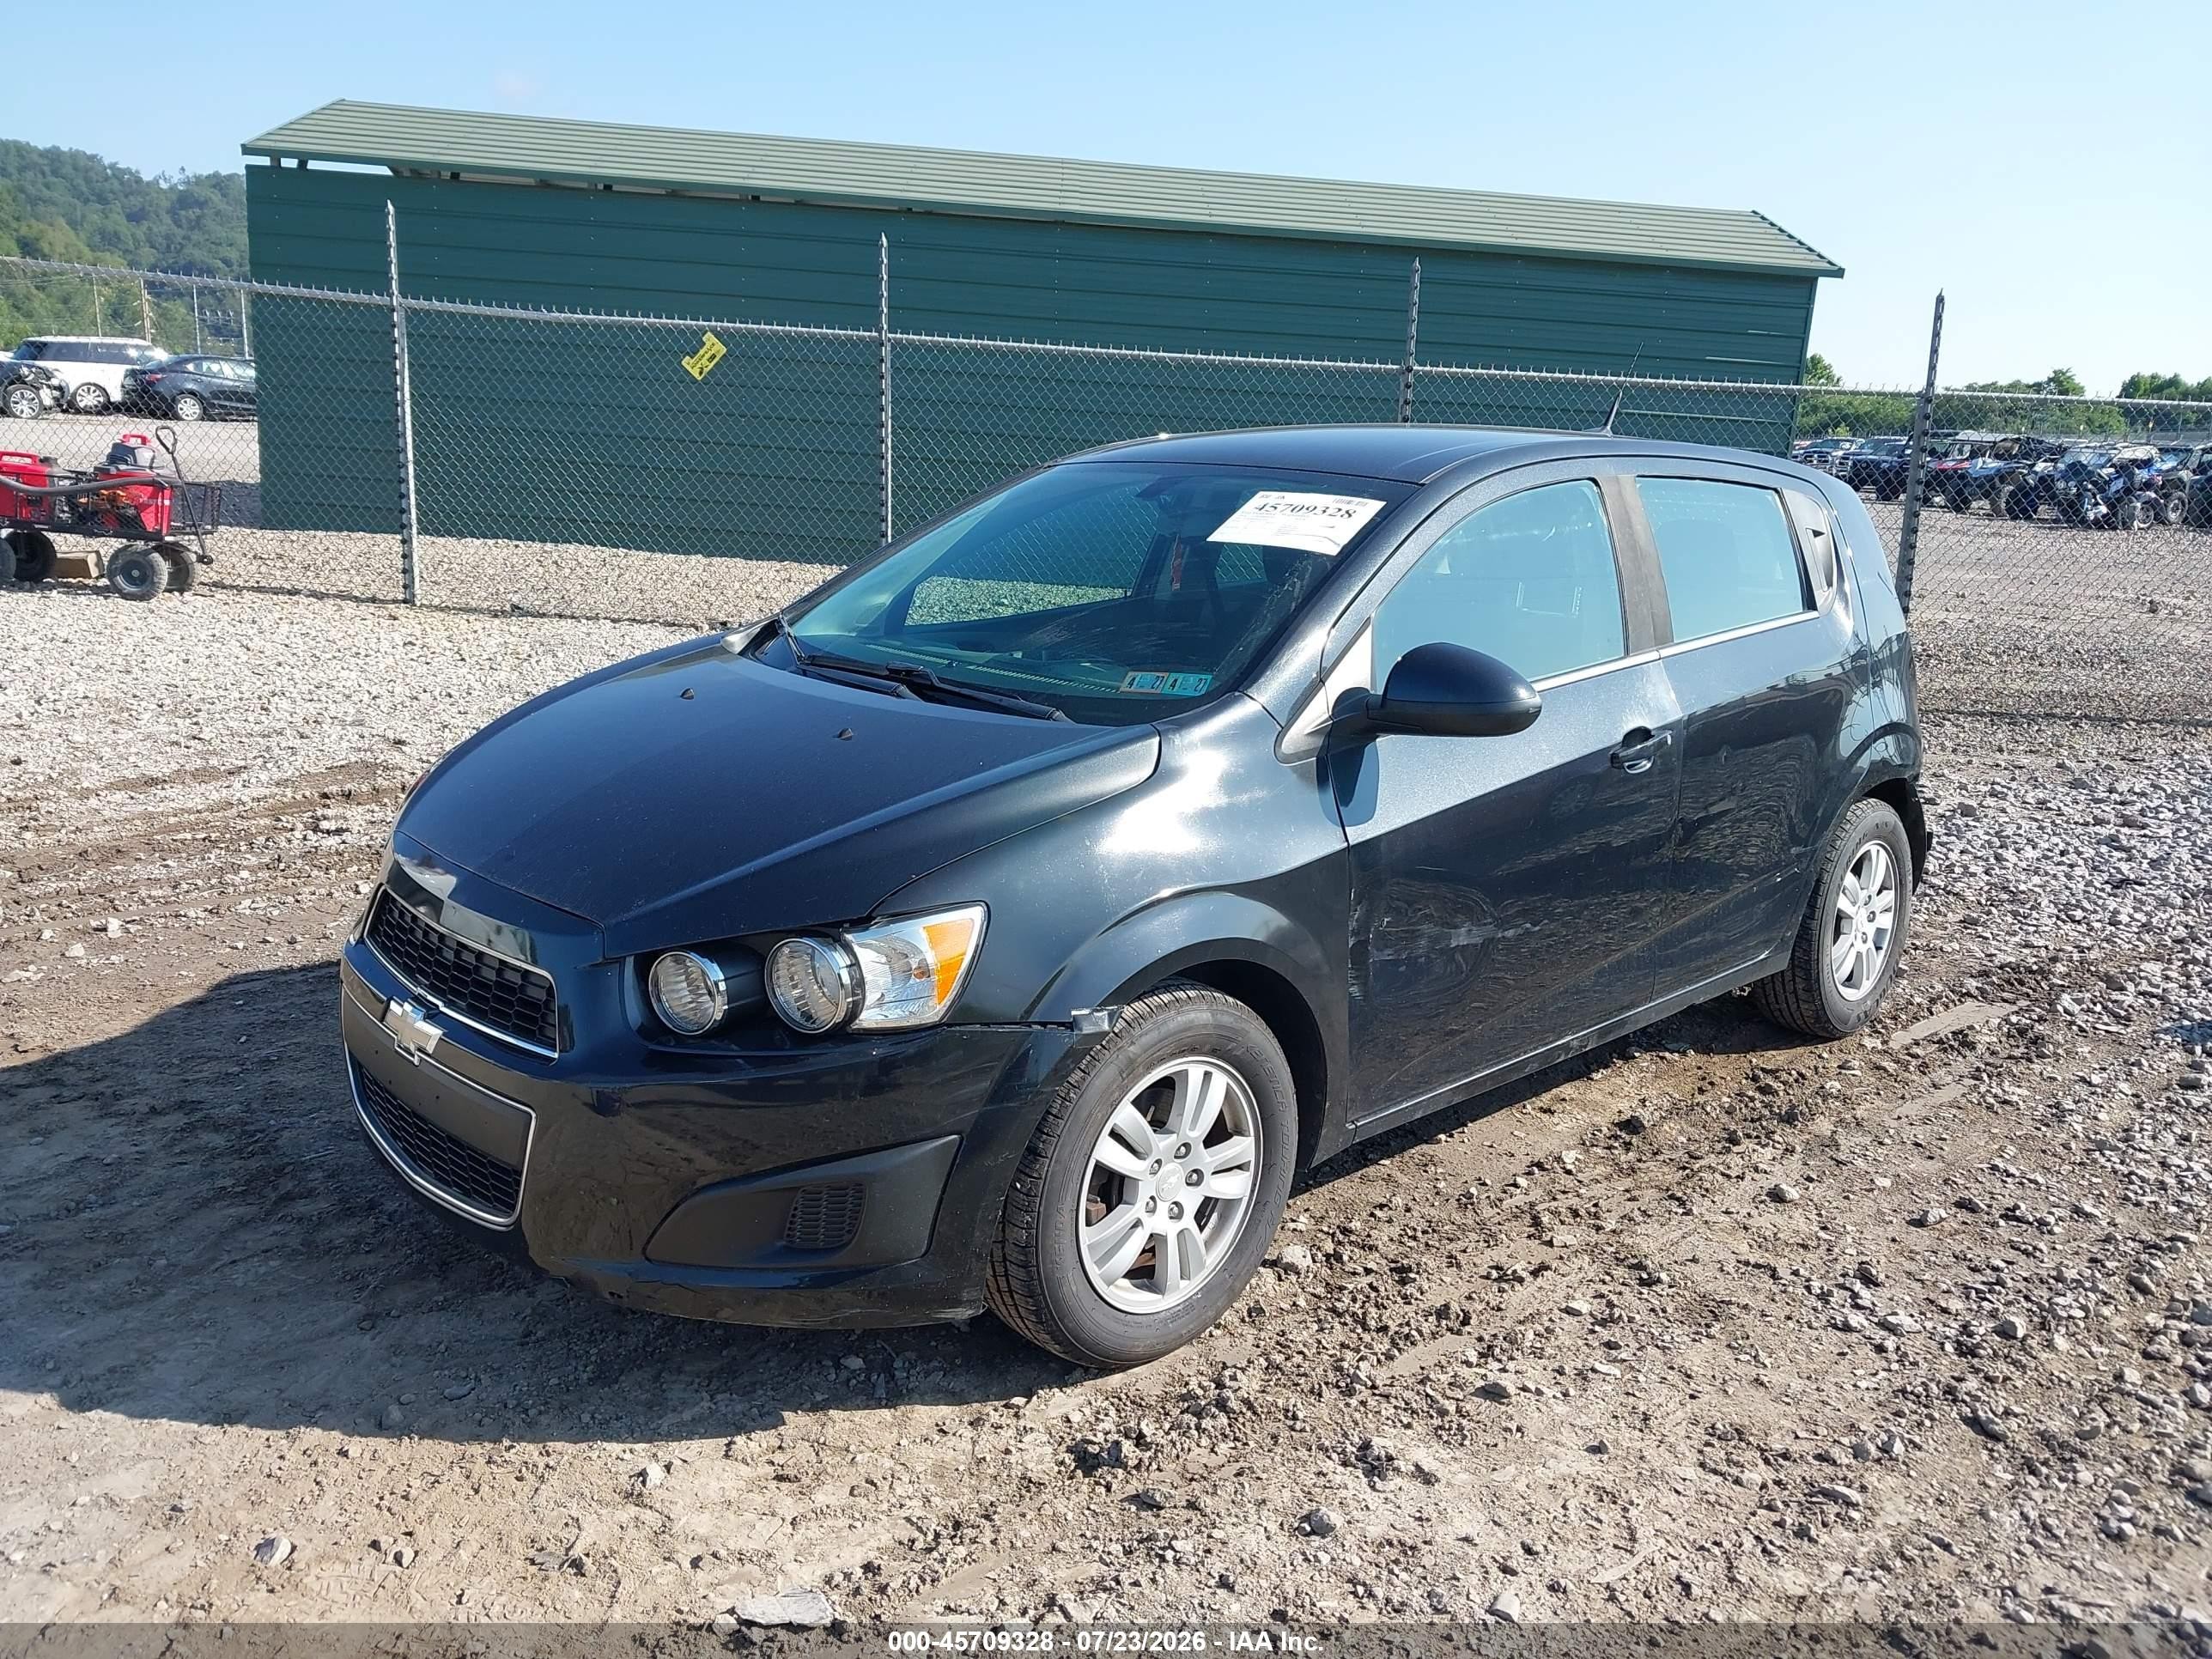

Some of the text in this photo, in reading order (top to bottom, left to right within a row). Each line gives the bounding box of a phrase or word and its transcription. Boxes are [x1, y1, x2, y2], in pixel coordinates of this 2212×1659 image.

[1254, 502, 1357, 520] 45709328
[1127, 675, 1165, 690] 4 27
[1169, 678, 1208, 694] 4 27
[1273, 1119, 1291, 1208] TOURING
